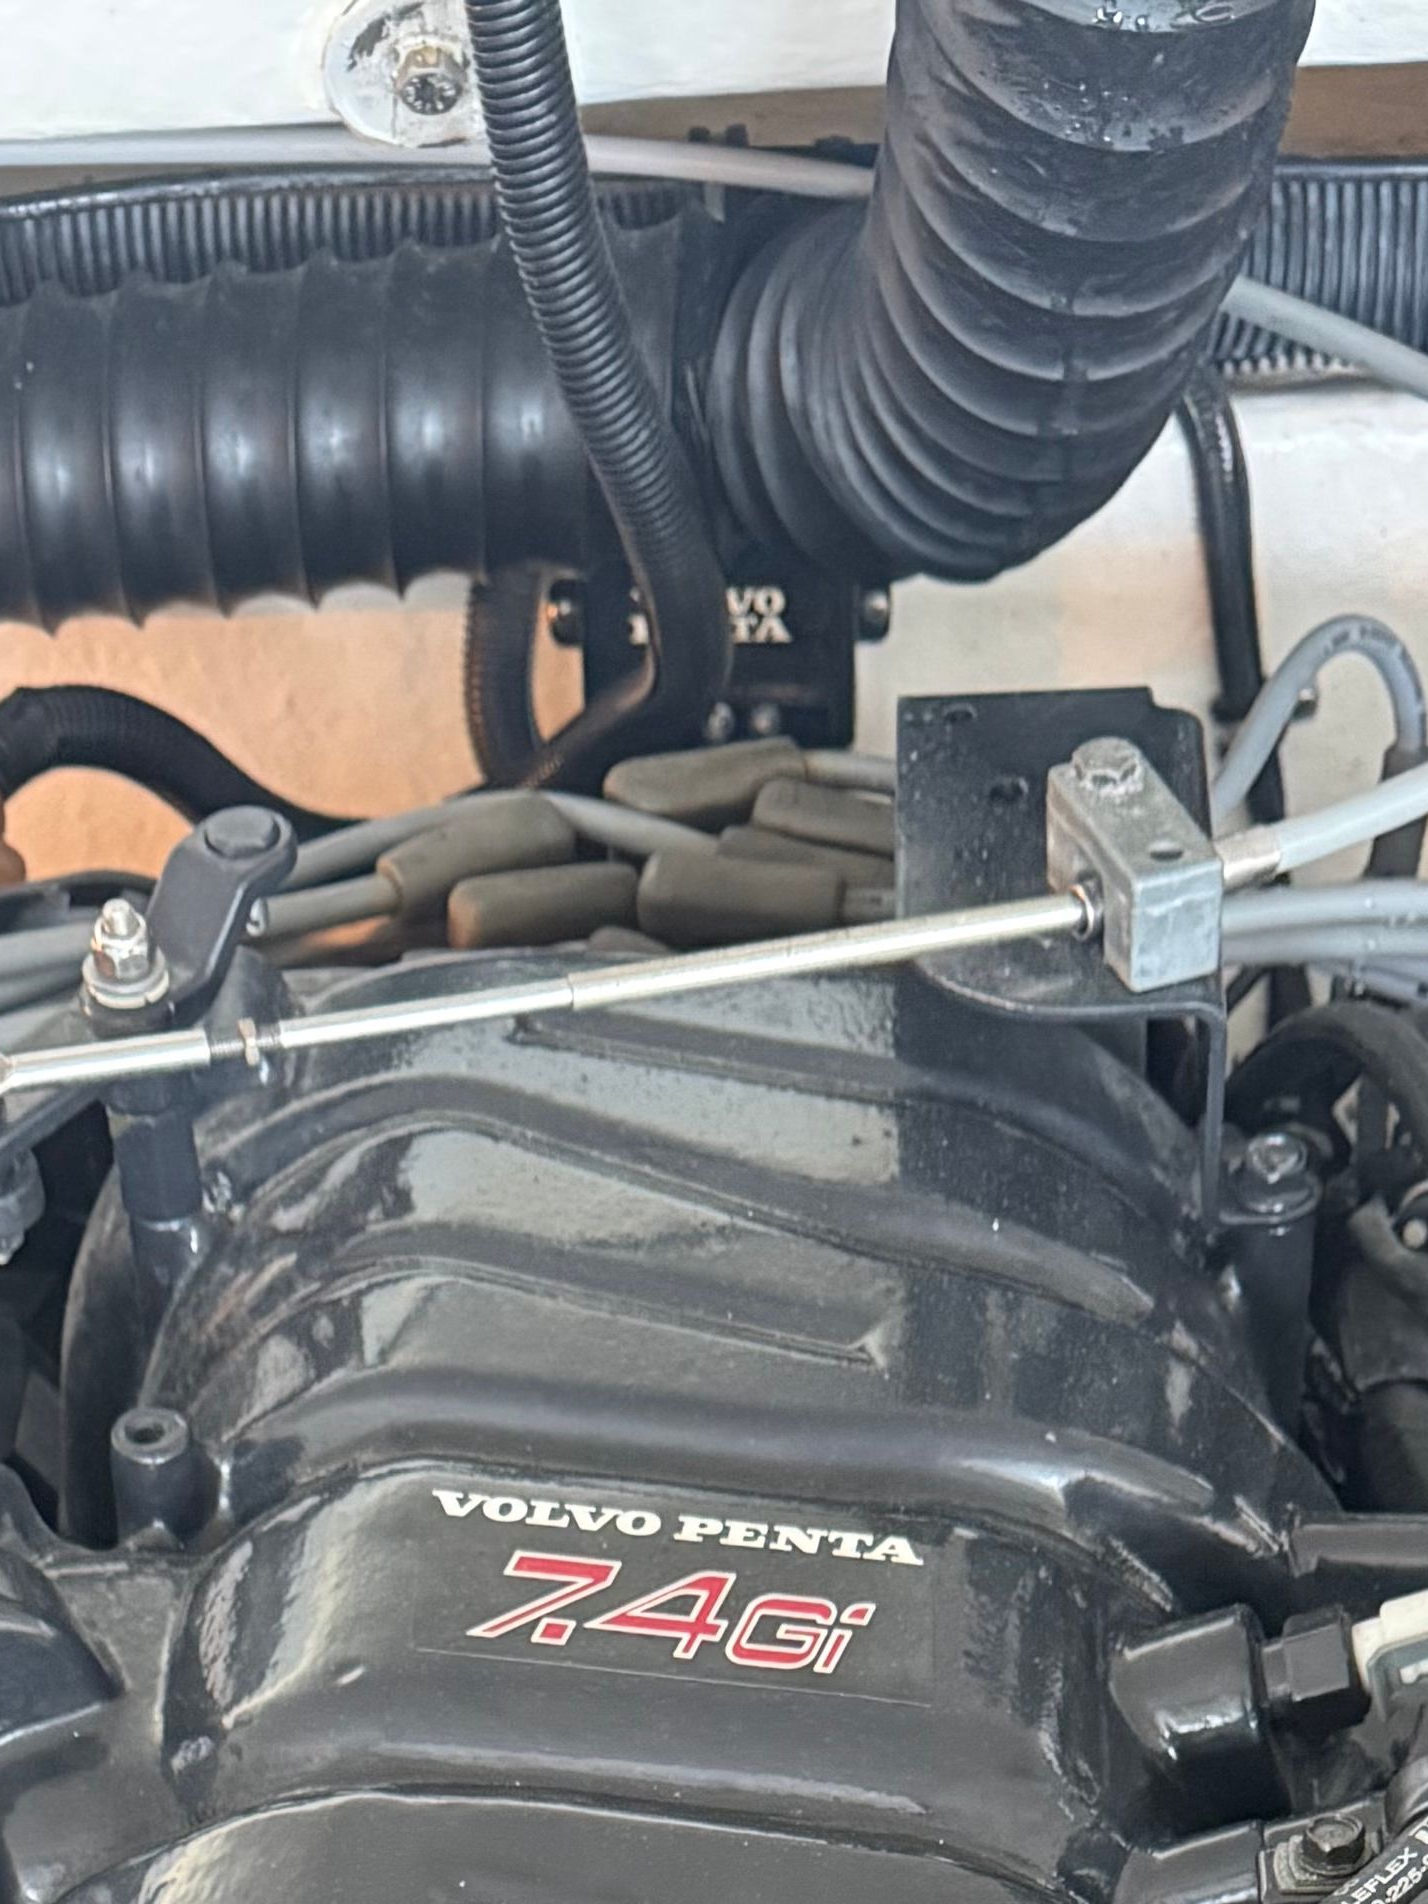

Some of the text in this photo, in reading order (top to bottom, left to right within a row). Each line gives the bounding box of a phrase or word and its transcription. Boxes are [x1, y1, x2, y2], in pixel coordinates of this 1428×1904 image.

[432, 1489, 924, 1565] VOLVO PENTA
[466, 1550, 876, 1675] 7.4Gi
